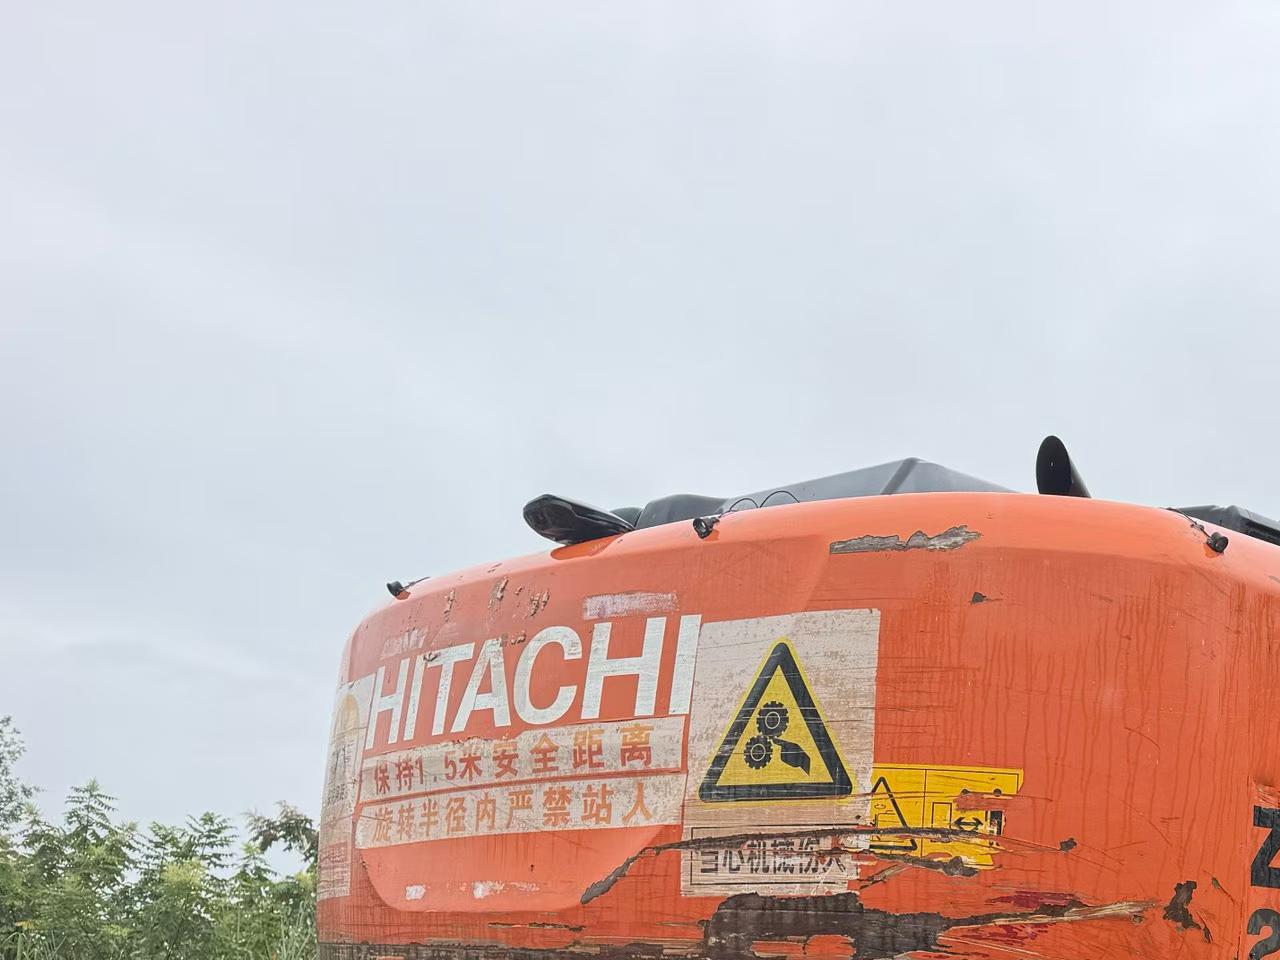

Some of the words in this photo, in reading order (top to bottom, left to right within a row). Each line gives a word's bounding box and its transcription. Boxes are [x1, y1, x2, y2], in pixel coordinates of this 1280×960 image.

[364, 614, 702, 751] HITACHI
[371, 782, 655, 842] 旋转半径内严禁站人
